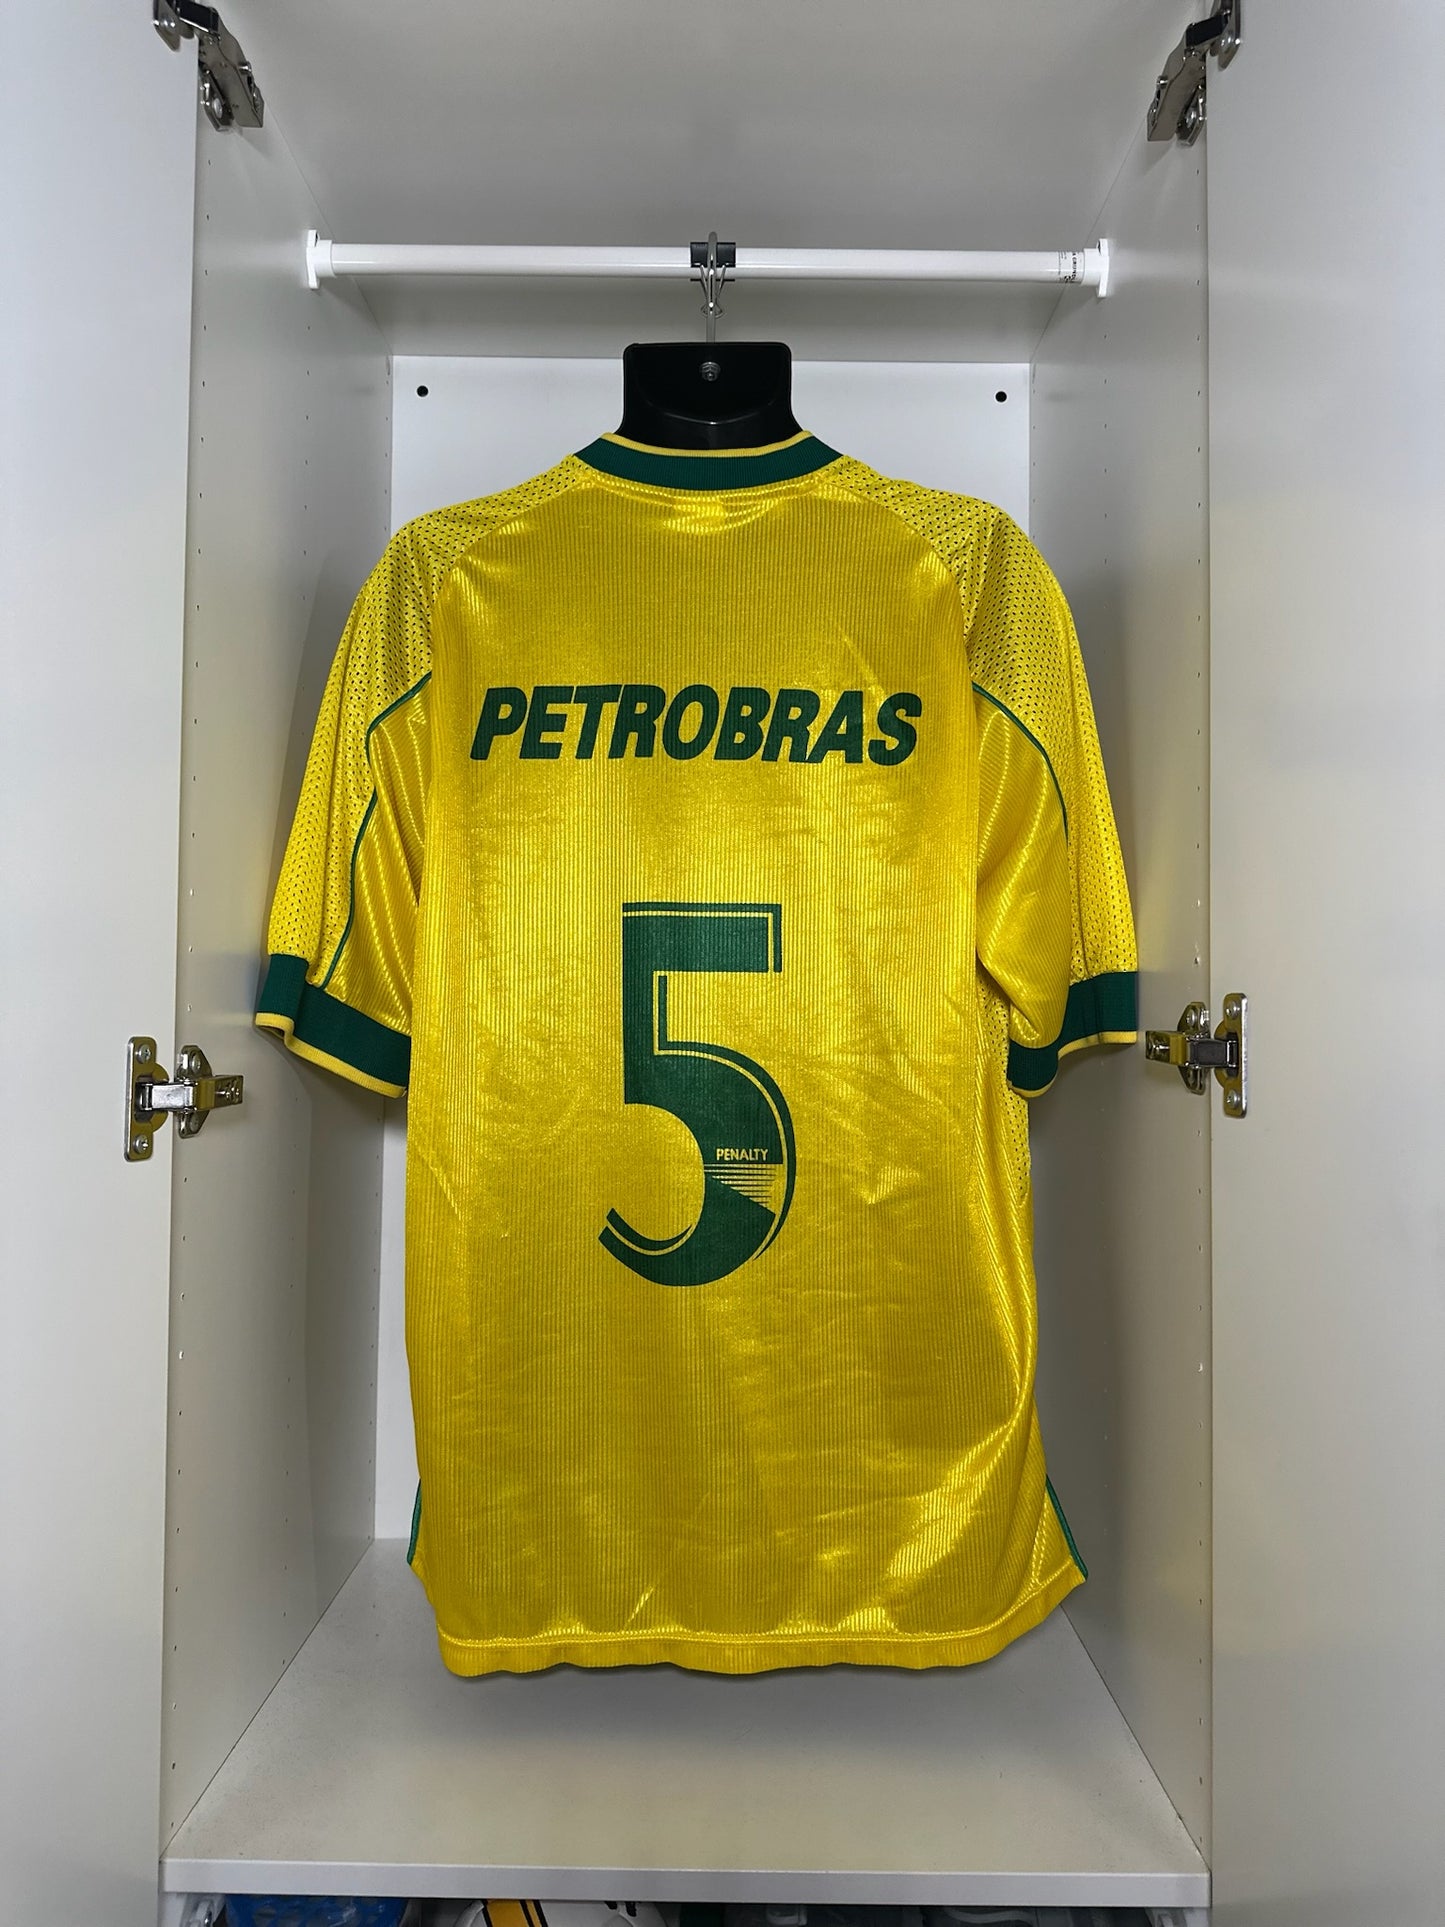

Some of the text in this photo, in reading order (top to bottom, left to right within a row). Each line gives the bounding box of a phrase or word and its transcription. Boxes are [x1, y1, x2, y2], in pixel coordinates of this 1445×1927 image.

[470, 684, 922, 766] PETROBRAS
[598, 902, 796, 1287] 5
[716, 1148, 768, 1161] PENALTY
